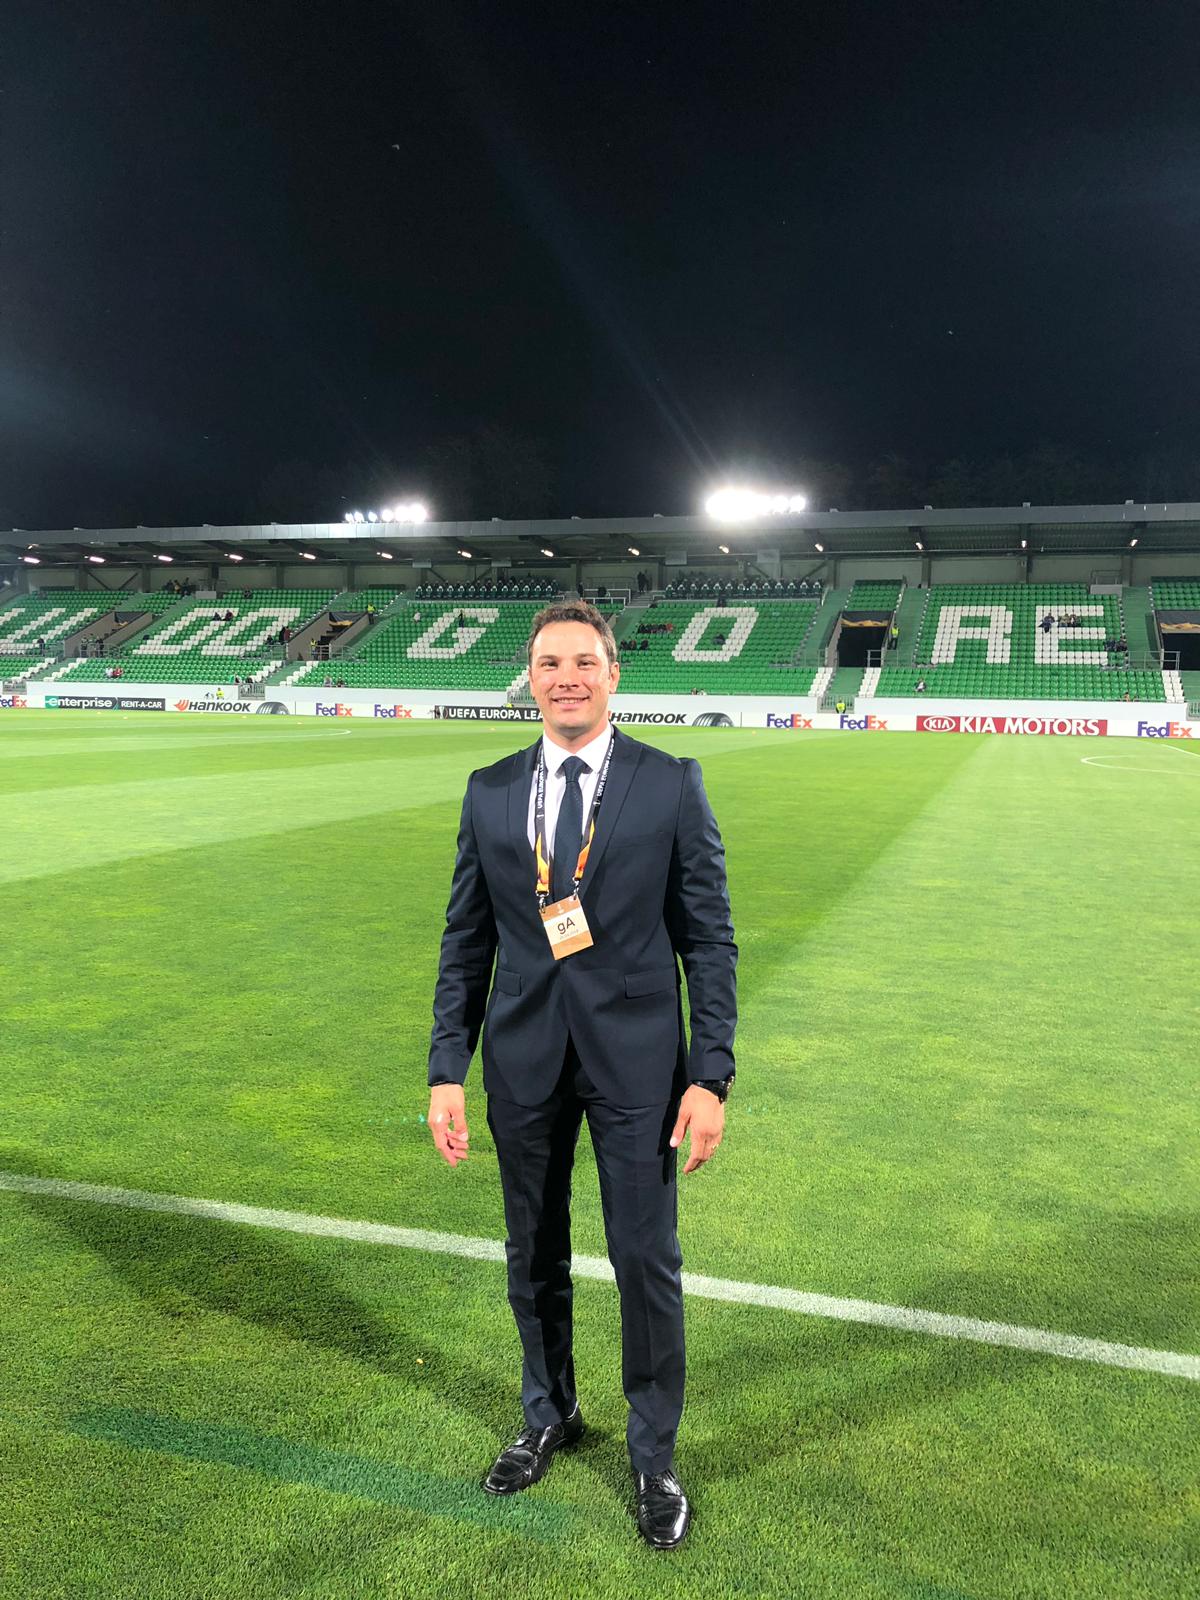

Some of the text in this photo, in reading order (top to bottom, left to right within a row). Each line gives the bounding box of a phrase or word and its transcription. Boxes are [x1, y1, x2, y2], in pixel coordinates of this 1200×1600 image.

[0, 695, 28, 708] edEx
[45, 696, 113, 709] enterprise
[121, 700, 162, 709] RENT-A-CAR
[315, 702, 353, 717] FedEx
[374, 704, 413, 719] FedEx
[448, 708, 477, 718] UEFA
[480, 709, 522, 720] EUROPA
[766, 713, 813, 729] FedEx
[839, 714, 888, 731] FedEx
[928, 719, 950, 729] KIA
[959, 717, 1100, 736] KIA MOTORS
[1137, 721, 1193, 738] FedEx
[557, 917, 576, 935] gA
